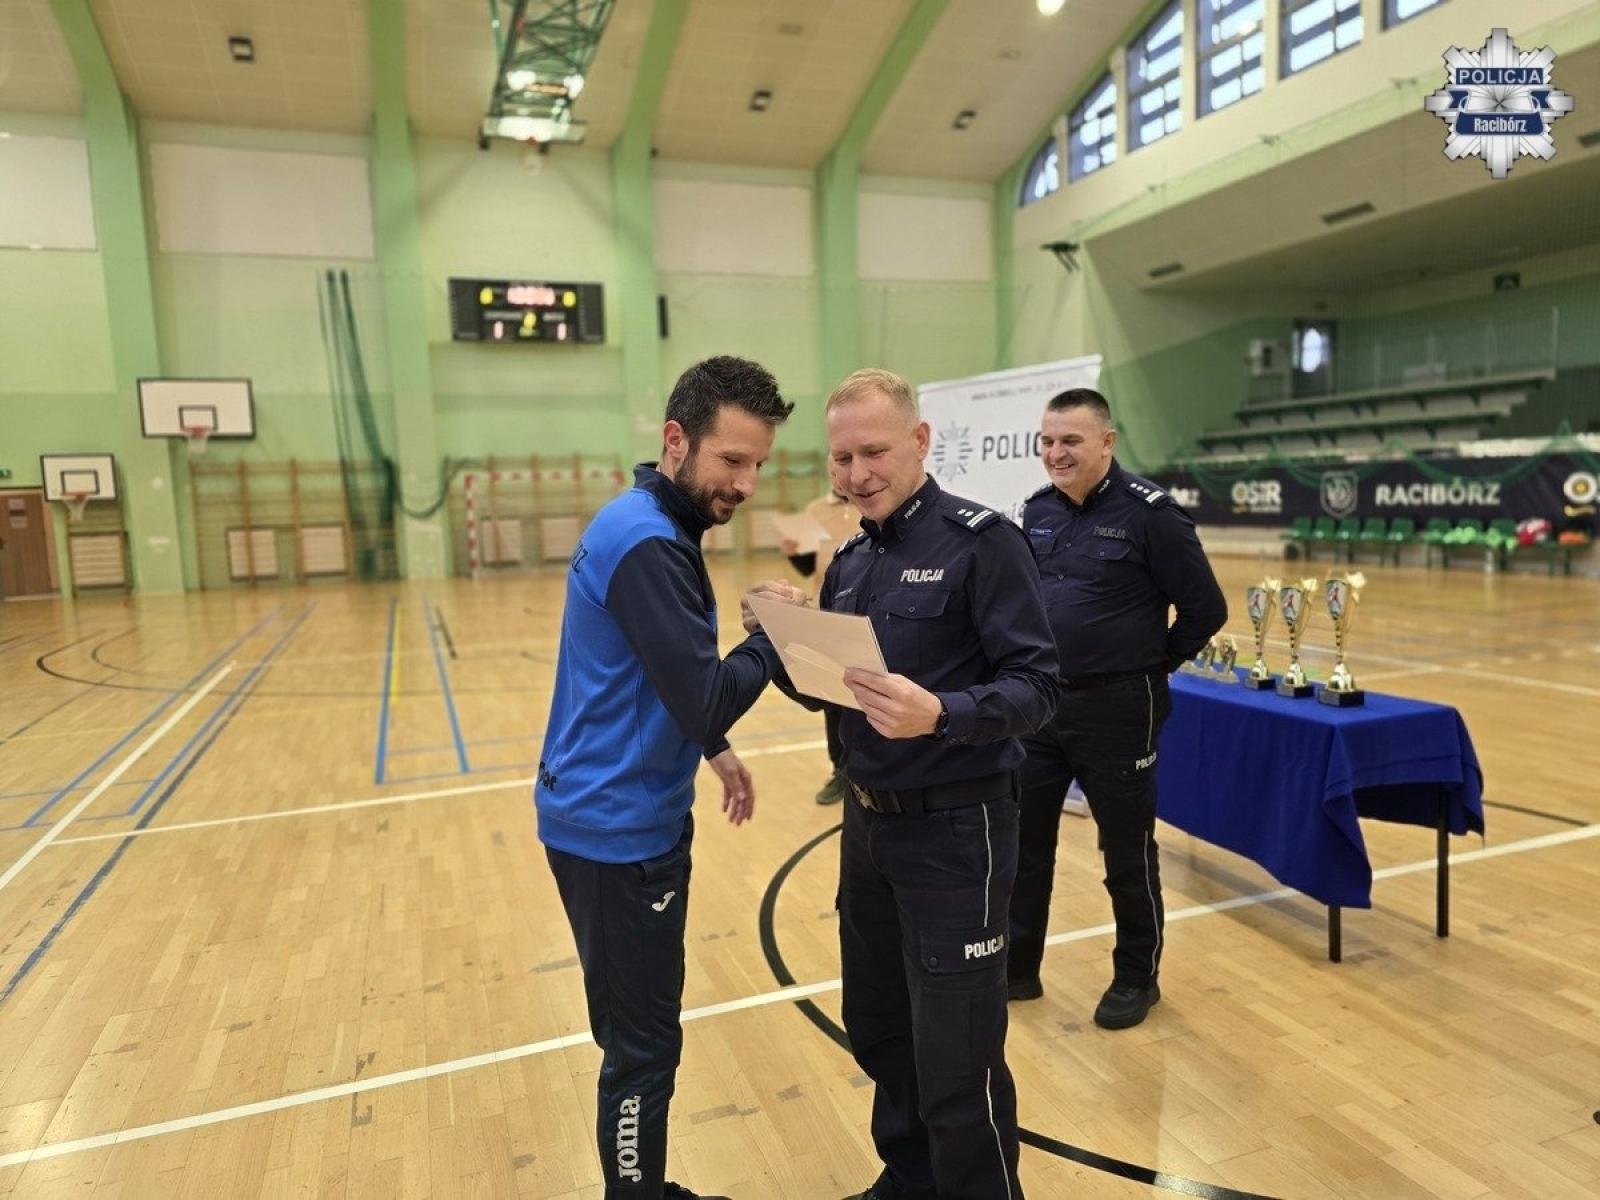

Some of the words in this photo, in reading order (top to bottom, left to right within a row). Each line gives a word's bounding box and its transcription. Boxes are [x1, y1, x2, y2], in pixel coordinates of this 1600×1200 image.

[982, 431, 1042, 461] POLIC
[1375, 477, 1500, 506] RACIBÓRZ
[900, 568, 944, 582] POLICJA
[616, 1095, 642, 1183] joma
